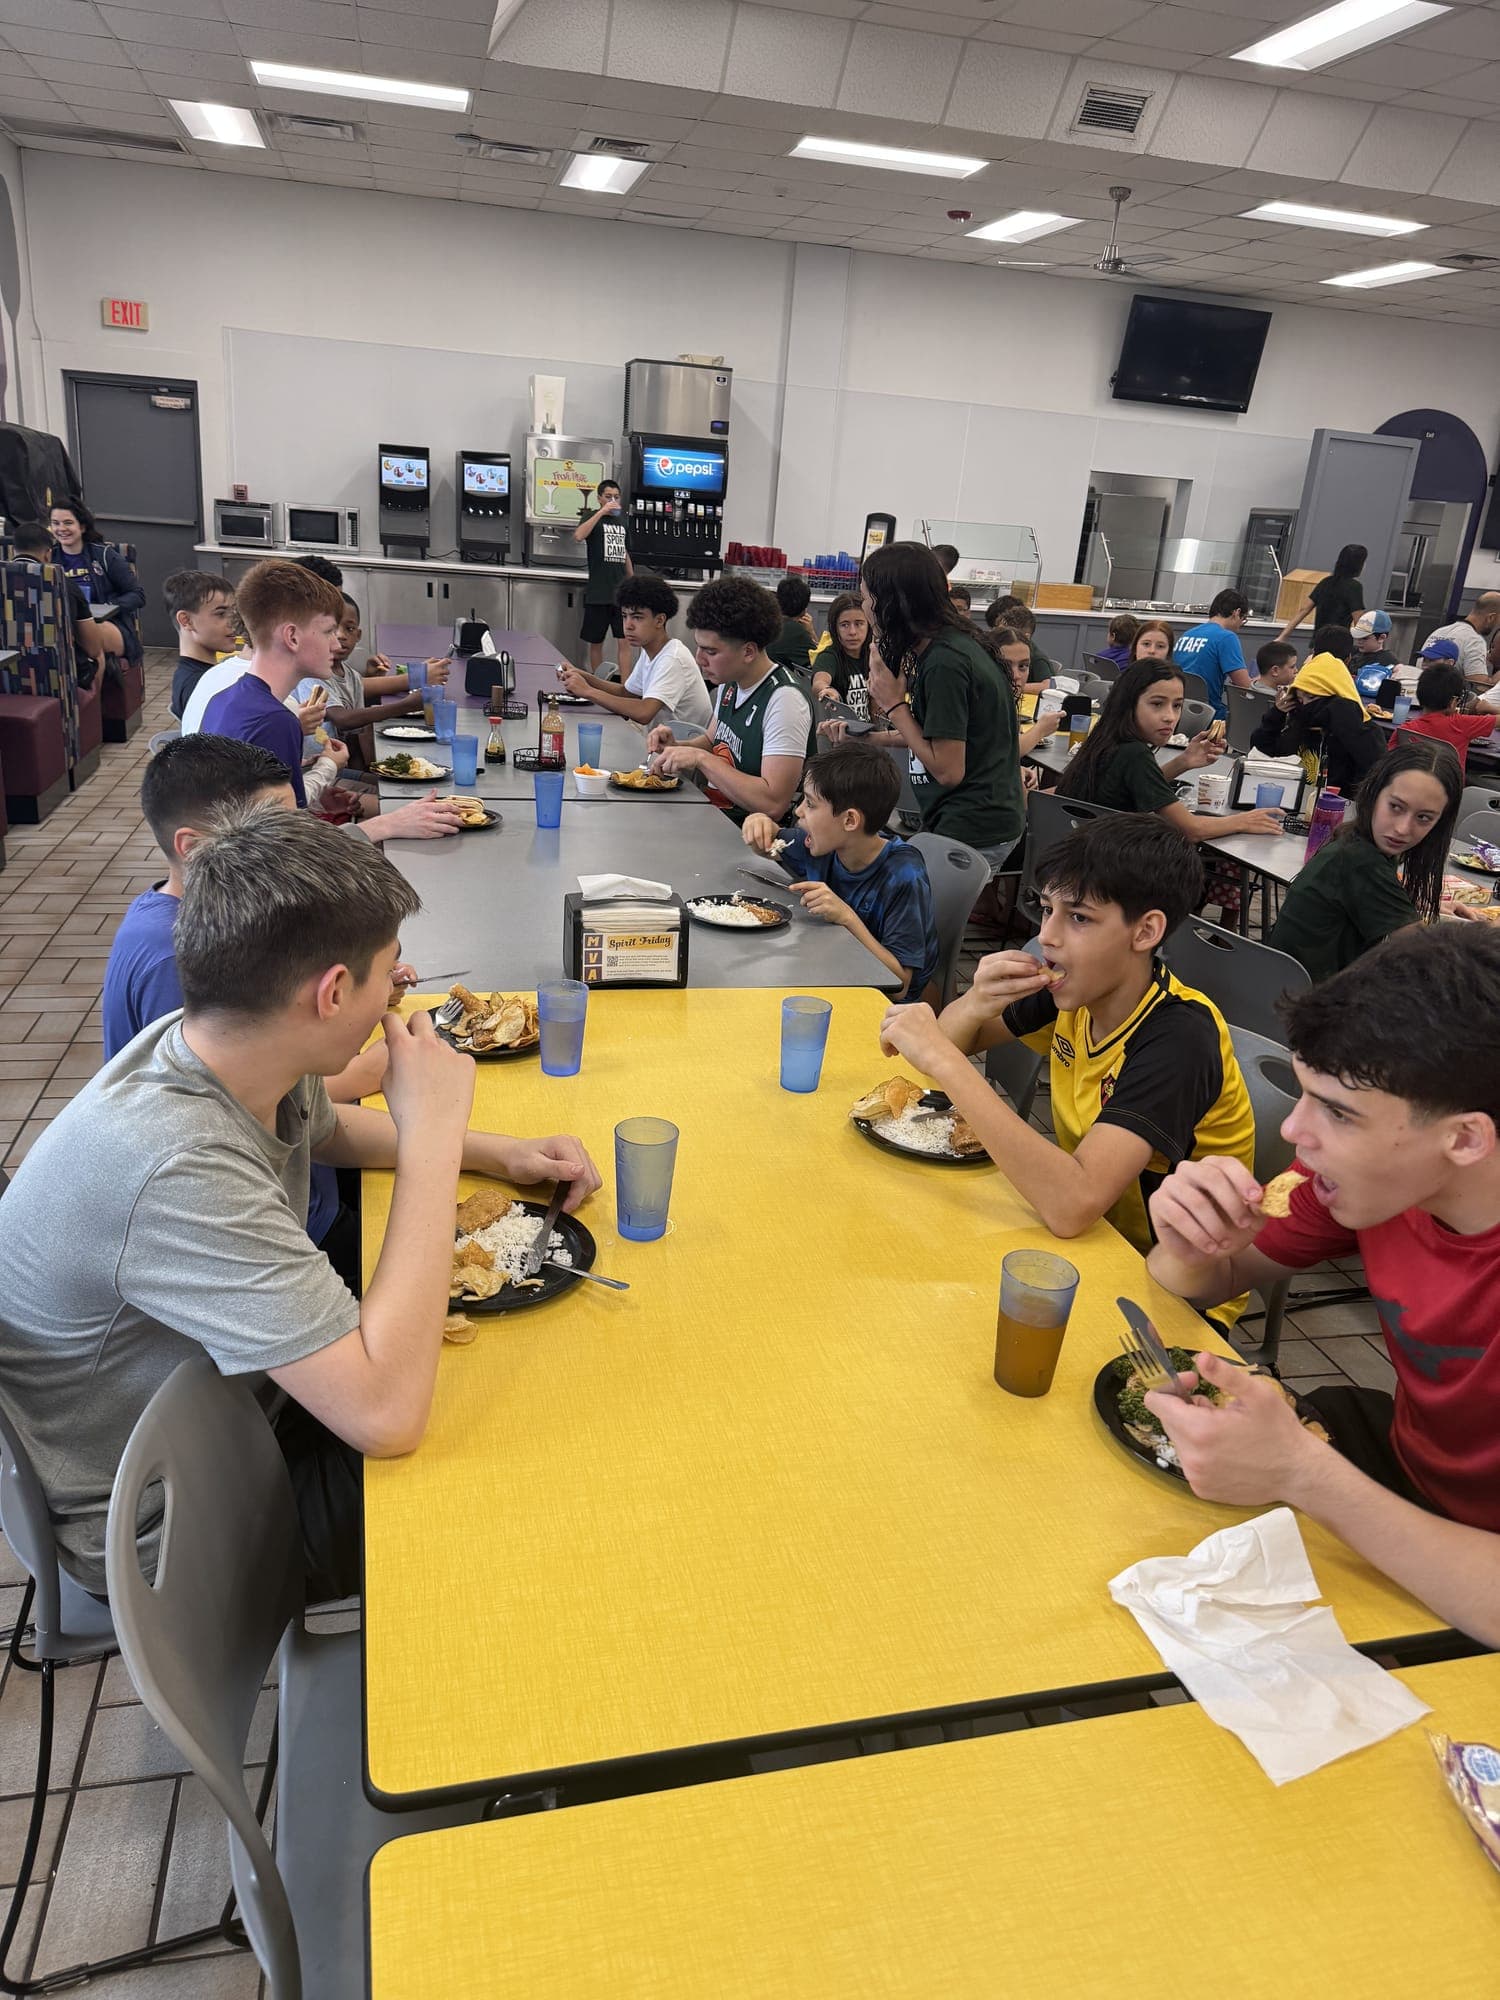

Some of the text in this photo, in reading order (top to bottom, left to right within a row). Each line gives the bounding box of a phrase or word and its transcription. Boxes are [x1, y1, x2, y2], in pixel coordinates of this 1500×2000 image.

[111, 299, 142, 326] EXIT
[675, 463, 714, 477] pepsi
[911, 775, 930, 785] USA
[609, 936, 671, 951] Spirit Friday
[1051, 1044, 1070, 1067] umbro
